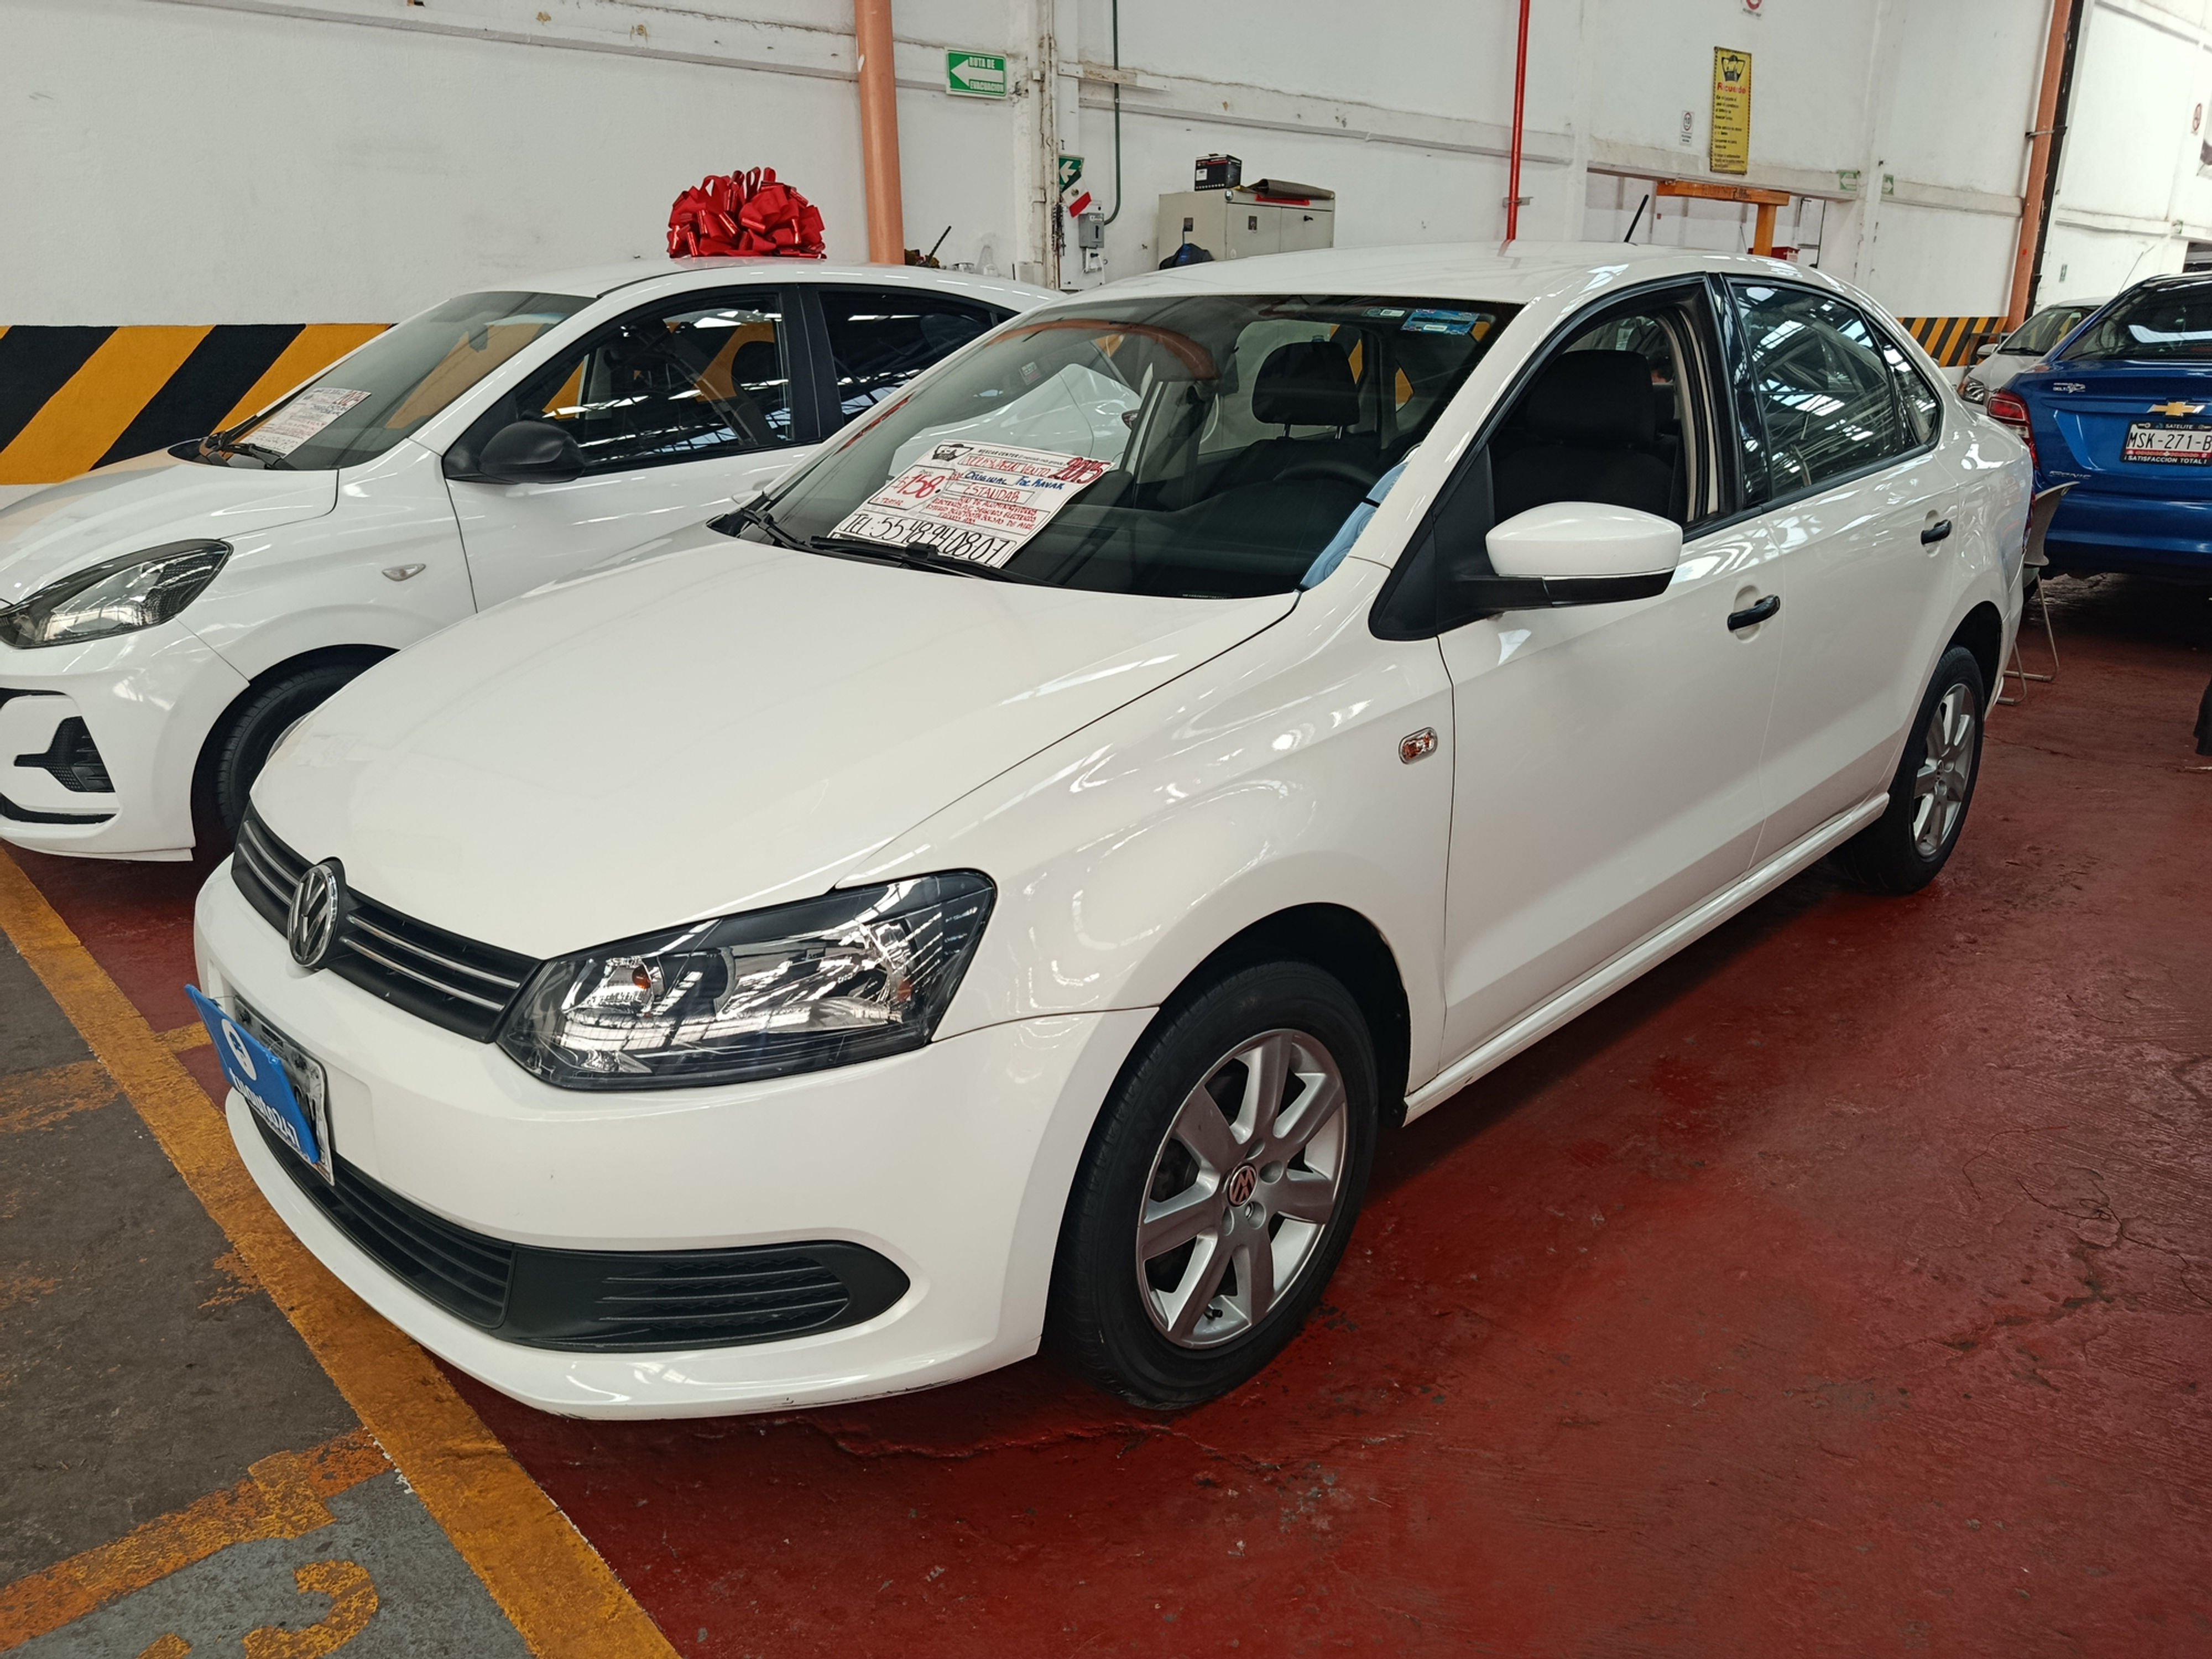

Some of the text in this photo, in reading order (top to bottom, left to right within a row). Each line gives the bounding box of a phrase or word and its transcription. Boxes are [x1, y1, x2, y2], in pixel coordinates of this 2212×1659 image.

[968, 56, 995, 69] RUTA DE
[2126, 432, 2212, 451] MSK-271-B
[1048, 457, 1111, 484] 2015
